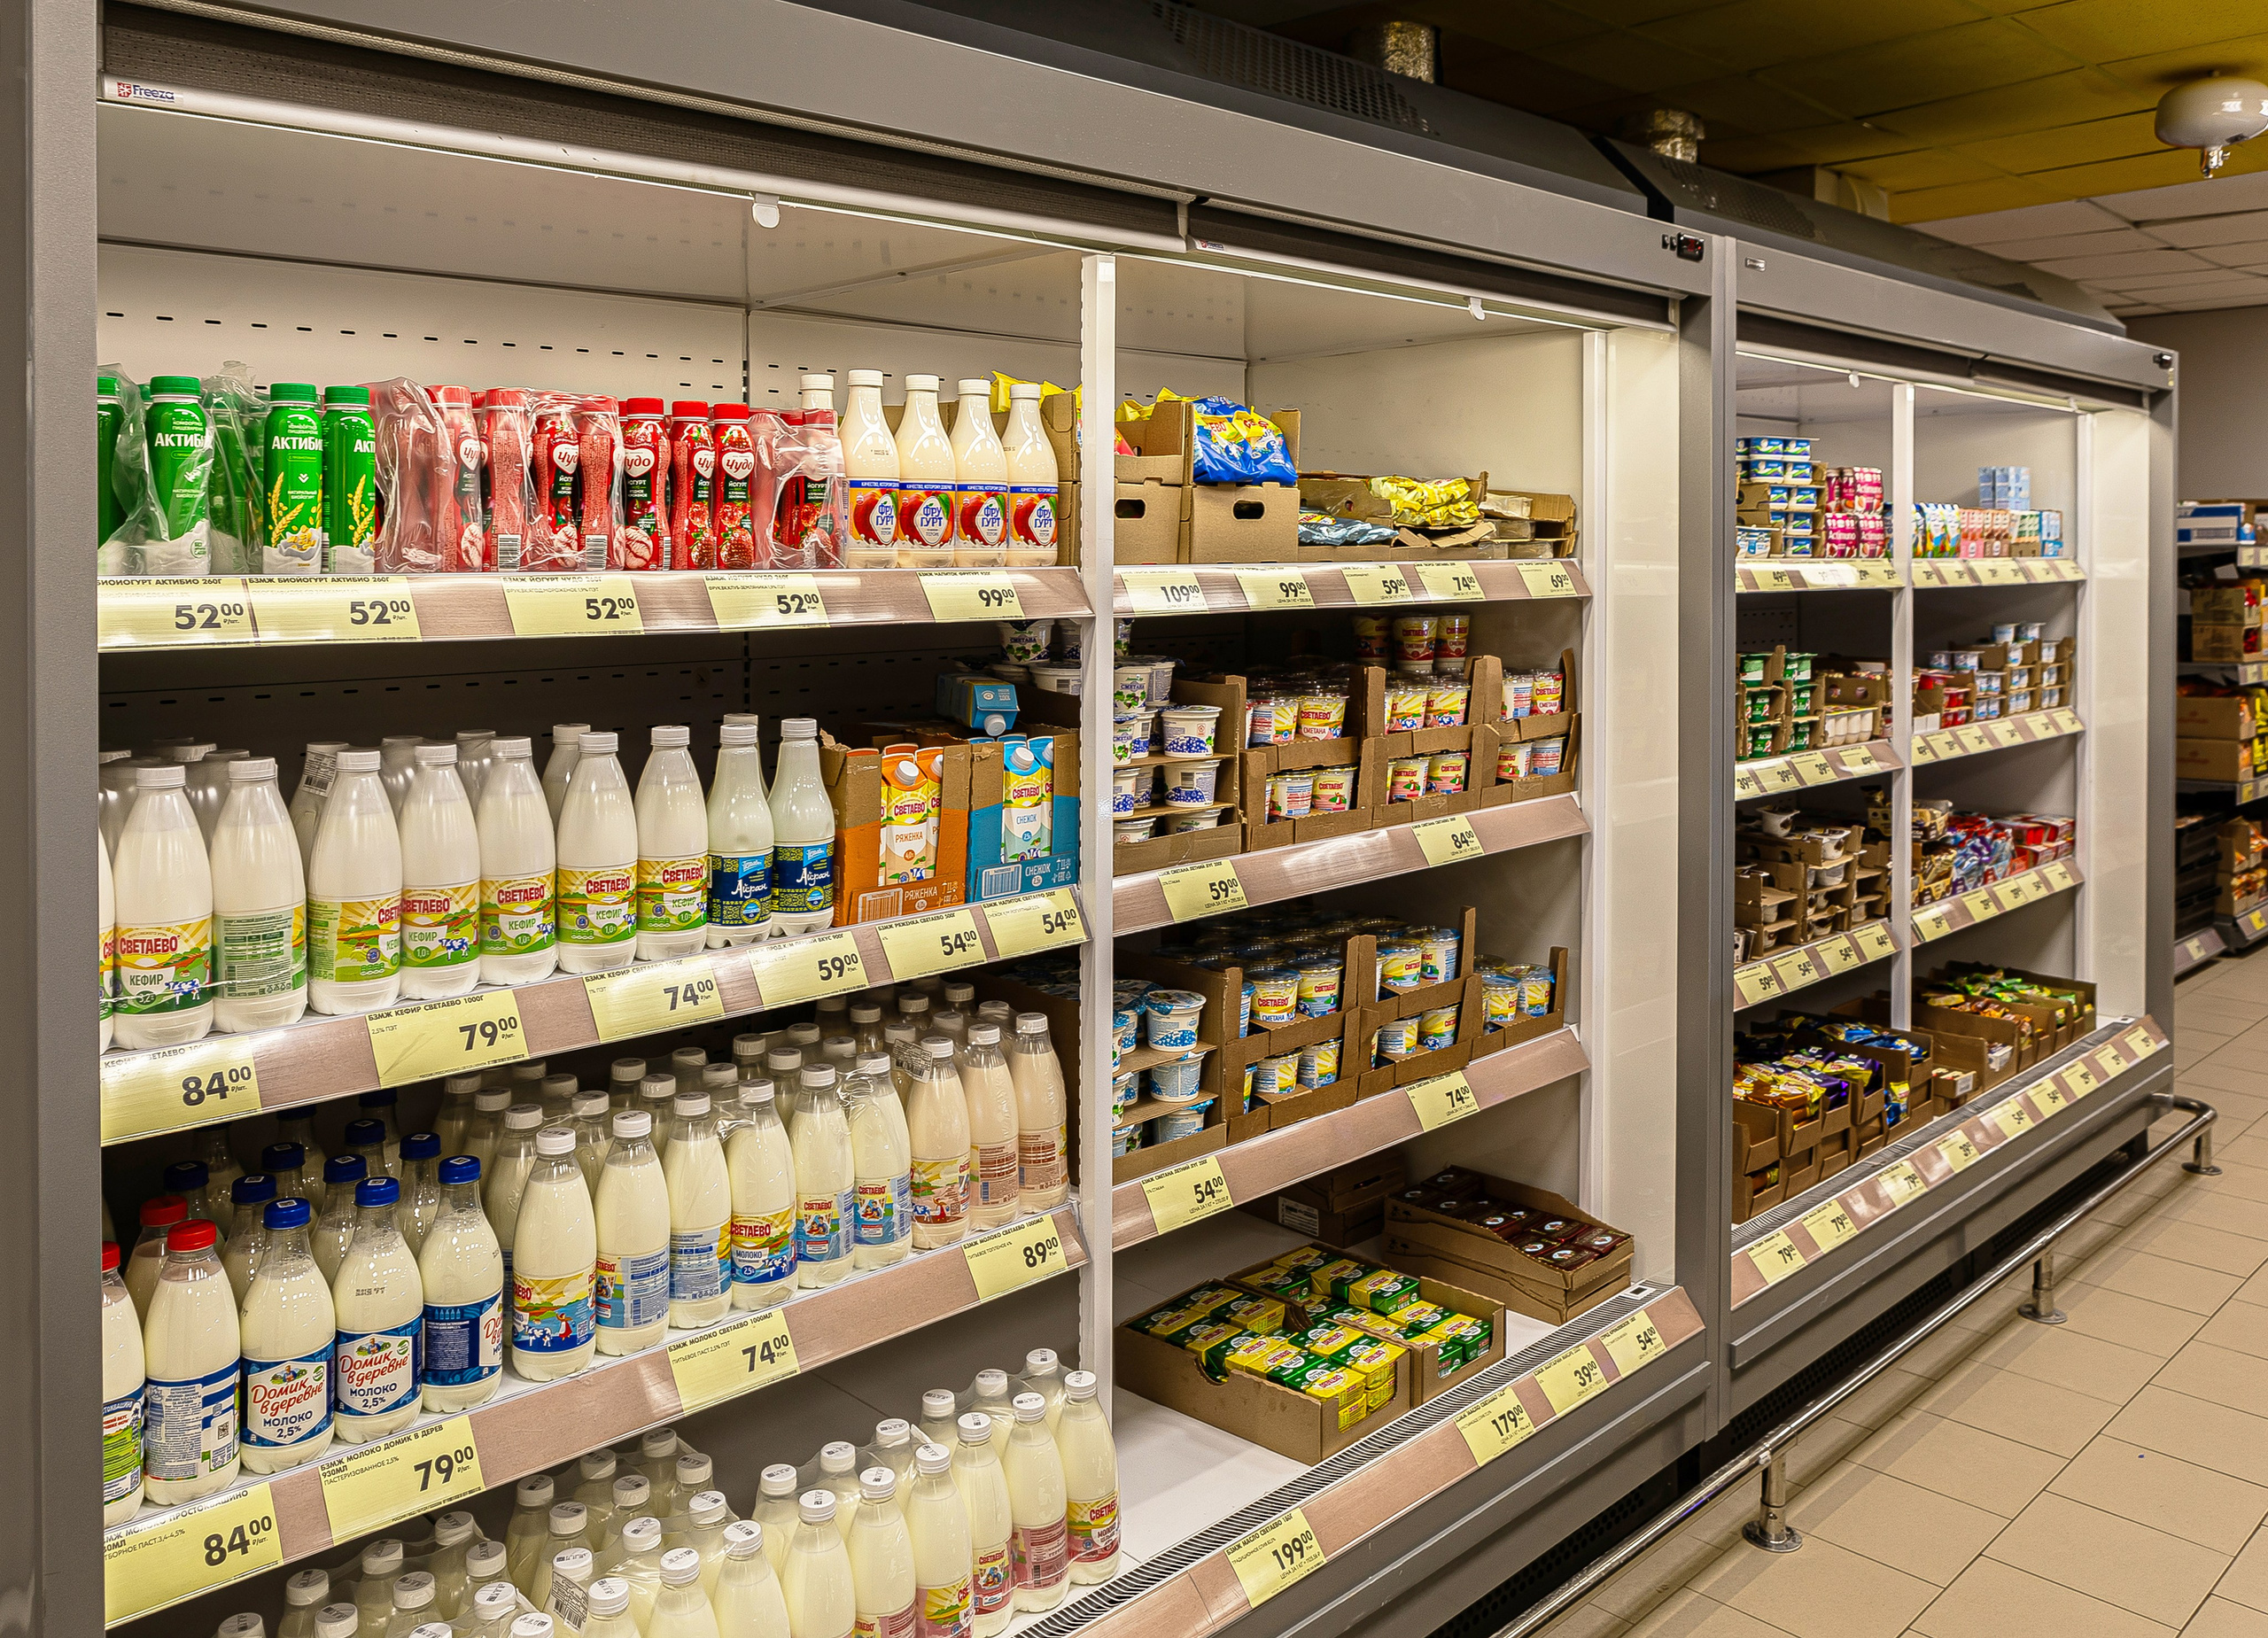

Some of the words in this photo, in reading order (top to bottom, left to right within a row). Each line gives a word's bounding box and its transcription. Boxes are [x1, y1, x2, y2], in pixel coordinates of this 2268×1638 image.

[133, 85, 175, 100] Freeza
[923, 505, 942, 517] ФРУ
[876, 516, 894, 526] ГУРТ
[920, 517, 944, 527] ГУРТ
[982, 517, 1000, 527] ГУРТ
[1035, 518, 1052, 528] ГУРТ
[1013, 786, 1040, 800] СВЕТАЕВО
[894, 802, 926, 817] СВЕТАЕВО
[1016, 813, 1037, 825] СНЕЖОК
[895, 831, 923, 843] РЯЖЕНКА
[662, 865, 704, 883] СВЕТАЕВО
[1025, 862, 1051, 876] СНЕЖОК
[586, 876, 631, 894] СВЕТАЕВО
[497, 884, 546, 904] СВЕТАЕВО
[905, 886, 937, 901] РЯЖЕНКА
[672, 897, 696, 908] КЕФИР
[998, 896, 1021, 906] НАПИТОК
[595, 909, 622, 920] КЕФИР
[895, 919, 919, 928] РЯЖЕНКА
[920, 914, 944, 925] СВЕТАЕВО
[509, 918, 537, 930] КЕФИР
[408, 931, 438, 943] КЕФИР
[120, 935, 179, 956] СВЕТАЕВО
[129, 973, 164, 987] КЕФИР
[585, 974, 606, 982] БЗМЖ
[608, 969, 630, 978] КЕФИР
[368, 1008, 393, 1021] БЗМЖ
[395, 1005, 422, 1017] КЕФИР
[423, 999, 462, 1012] СВЕТАЕВО
[463, 994, 485, 1005] 1000Г
[1257, 997, 1290, 1008] СВЕТАЕВО
[385, 1024, 398, 1033] ПЭТ
[731, 1223, 773, 1238] СВЕТАЕВО
[979, 1232, 1001, 1244] МОЛОКО
[1002, 1224, 1025, 1236] СВЕТАЕВО
[735, 1249, 763, 1261] МОЛОКО
[668, 1341, 688, 1353] БЗМЖ
[689, 1331, 718, 1346] МОЛОКО
[718, 1320, 749, 1335] СВЕТАЕВО
[750, 1312, 773, 1324] 1000МЛ
[338, 1352, 393, 1374] Домик
[672, 1353, 697, 1365] ПИТЬЕВОЕ
[251, 1378, 309, 1404] Домик
[349, 1382, 397, 1398] МОЛОКО
[361, 1396, 386, 1409] 2,5%
[262, 1409, 313, 1427] МОЛОКО
[276, 1425, 301, 1440] 2,5%
[321, 1456, 346, 1471] БЗМЖ
[346, 1446, 382, 1463] МОЛОКО
[384, 1436, 413, 1450] ДОМИК
[421, 1425, 444, 1439] ДЕРЕВ
[322, 1463, 348, 1478] 930МЛ
[324, 1461, 386, 1487] ПАСТЕРИЗОВАННОЕ
[1226, 1543, 1242, 1556] БЗМЖ
[1241, 1533, 1260, 1547] МАСЛО
[1260, 1519, 1283, 1536] СВЕТАЕВО
[105, 1545, 137, 1560] ТБОРНОЕ
